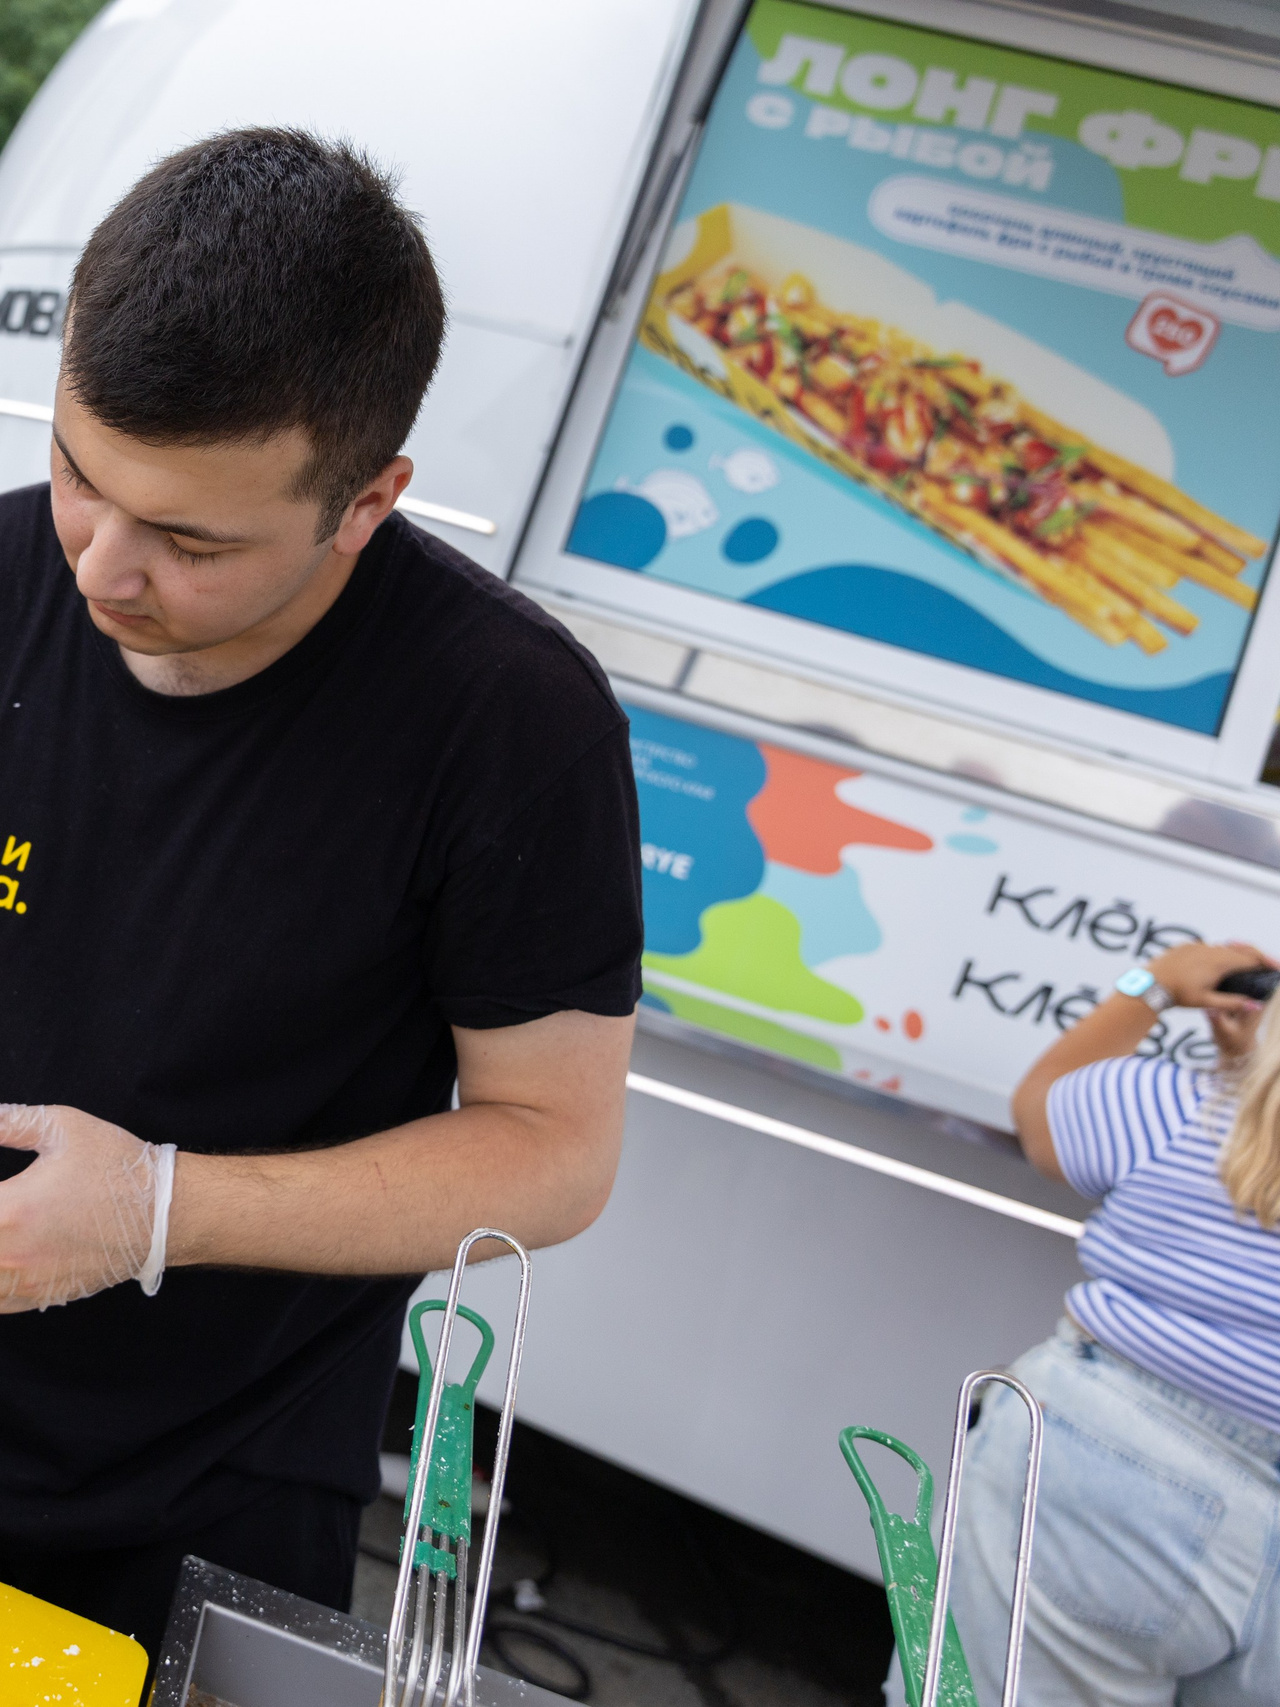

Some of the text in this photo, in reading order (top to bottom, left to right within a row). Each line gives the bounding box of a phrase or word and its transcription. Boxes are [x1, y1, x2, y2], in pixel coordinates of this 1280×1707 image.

[757, 33, 1060, 141] ЛОНГ
[745, 91, 1054, 193] С РЫБОЙ
[1, 835, 32, 872] и
